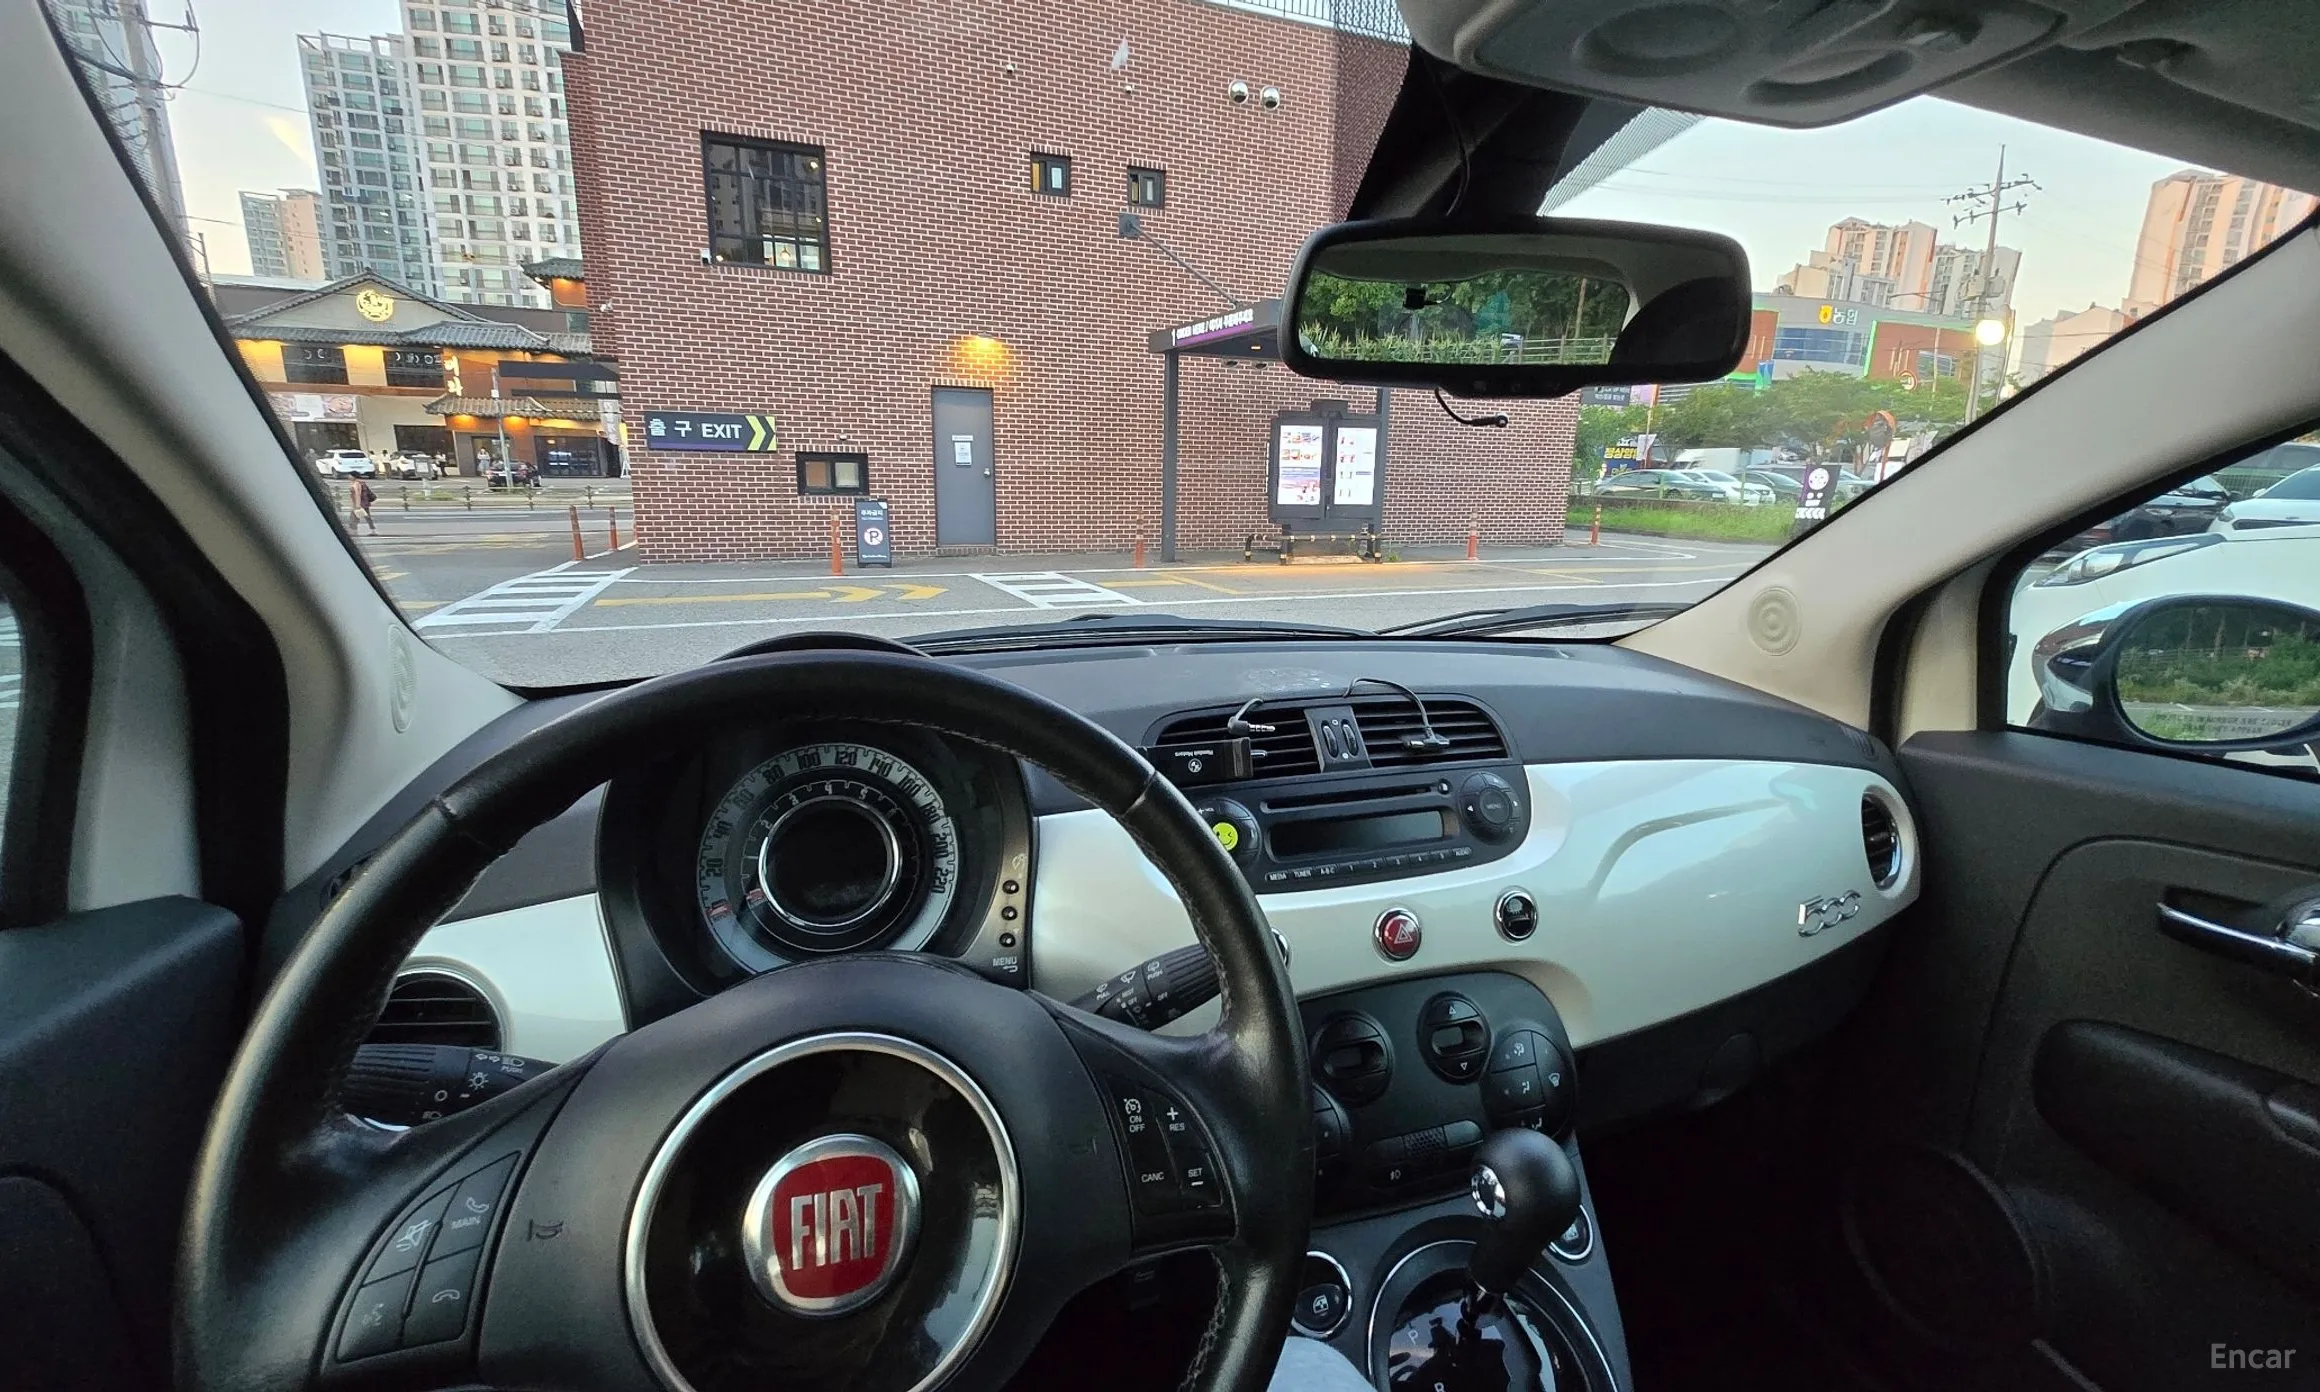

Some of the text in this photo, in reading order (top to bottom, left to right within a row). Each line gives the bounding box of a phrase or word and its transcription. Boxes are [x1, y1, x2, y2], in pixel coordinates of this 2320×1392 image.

[1833, 307, 1858, 326] 농협
[701, 422, 742, 439] EXIT
[834, 750, 858, 766] 120
[868, 756, 893, 778] 140
[899, 774, 921, 797] 160
[919, 802, 941, 824] 180
[714, 820, 734, 840] 40
[931, 832, 950, 859] 200
[705, 857, 724, 878] 20
[931, 867, 949, 894] 220
[1798, 889, 1861, 937] 500
[993, 956, 1018, 967] MENU
[1147, 969, 1163, 980] PUSH
[501, 1065, 523, 1074] PUSH
[1129, 1115, 1142, 1124] ON
[1169, 1122, 1185, 1131] RES
[1129, 1123, 1145, 1133] OFF
[1141, 1171, 1165, 1183] CANC
[1188, 1167, 1203, 1178] SET
[451, 1215, 483, 1230] MAIN
[791, 1183, 883, 1271] FIAT
[1407, 1330, 1419, 1345] P
